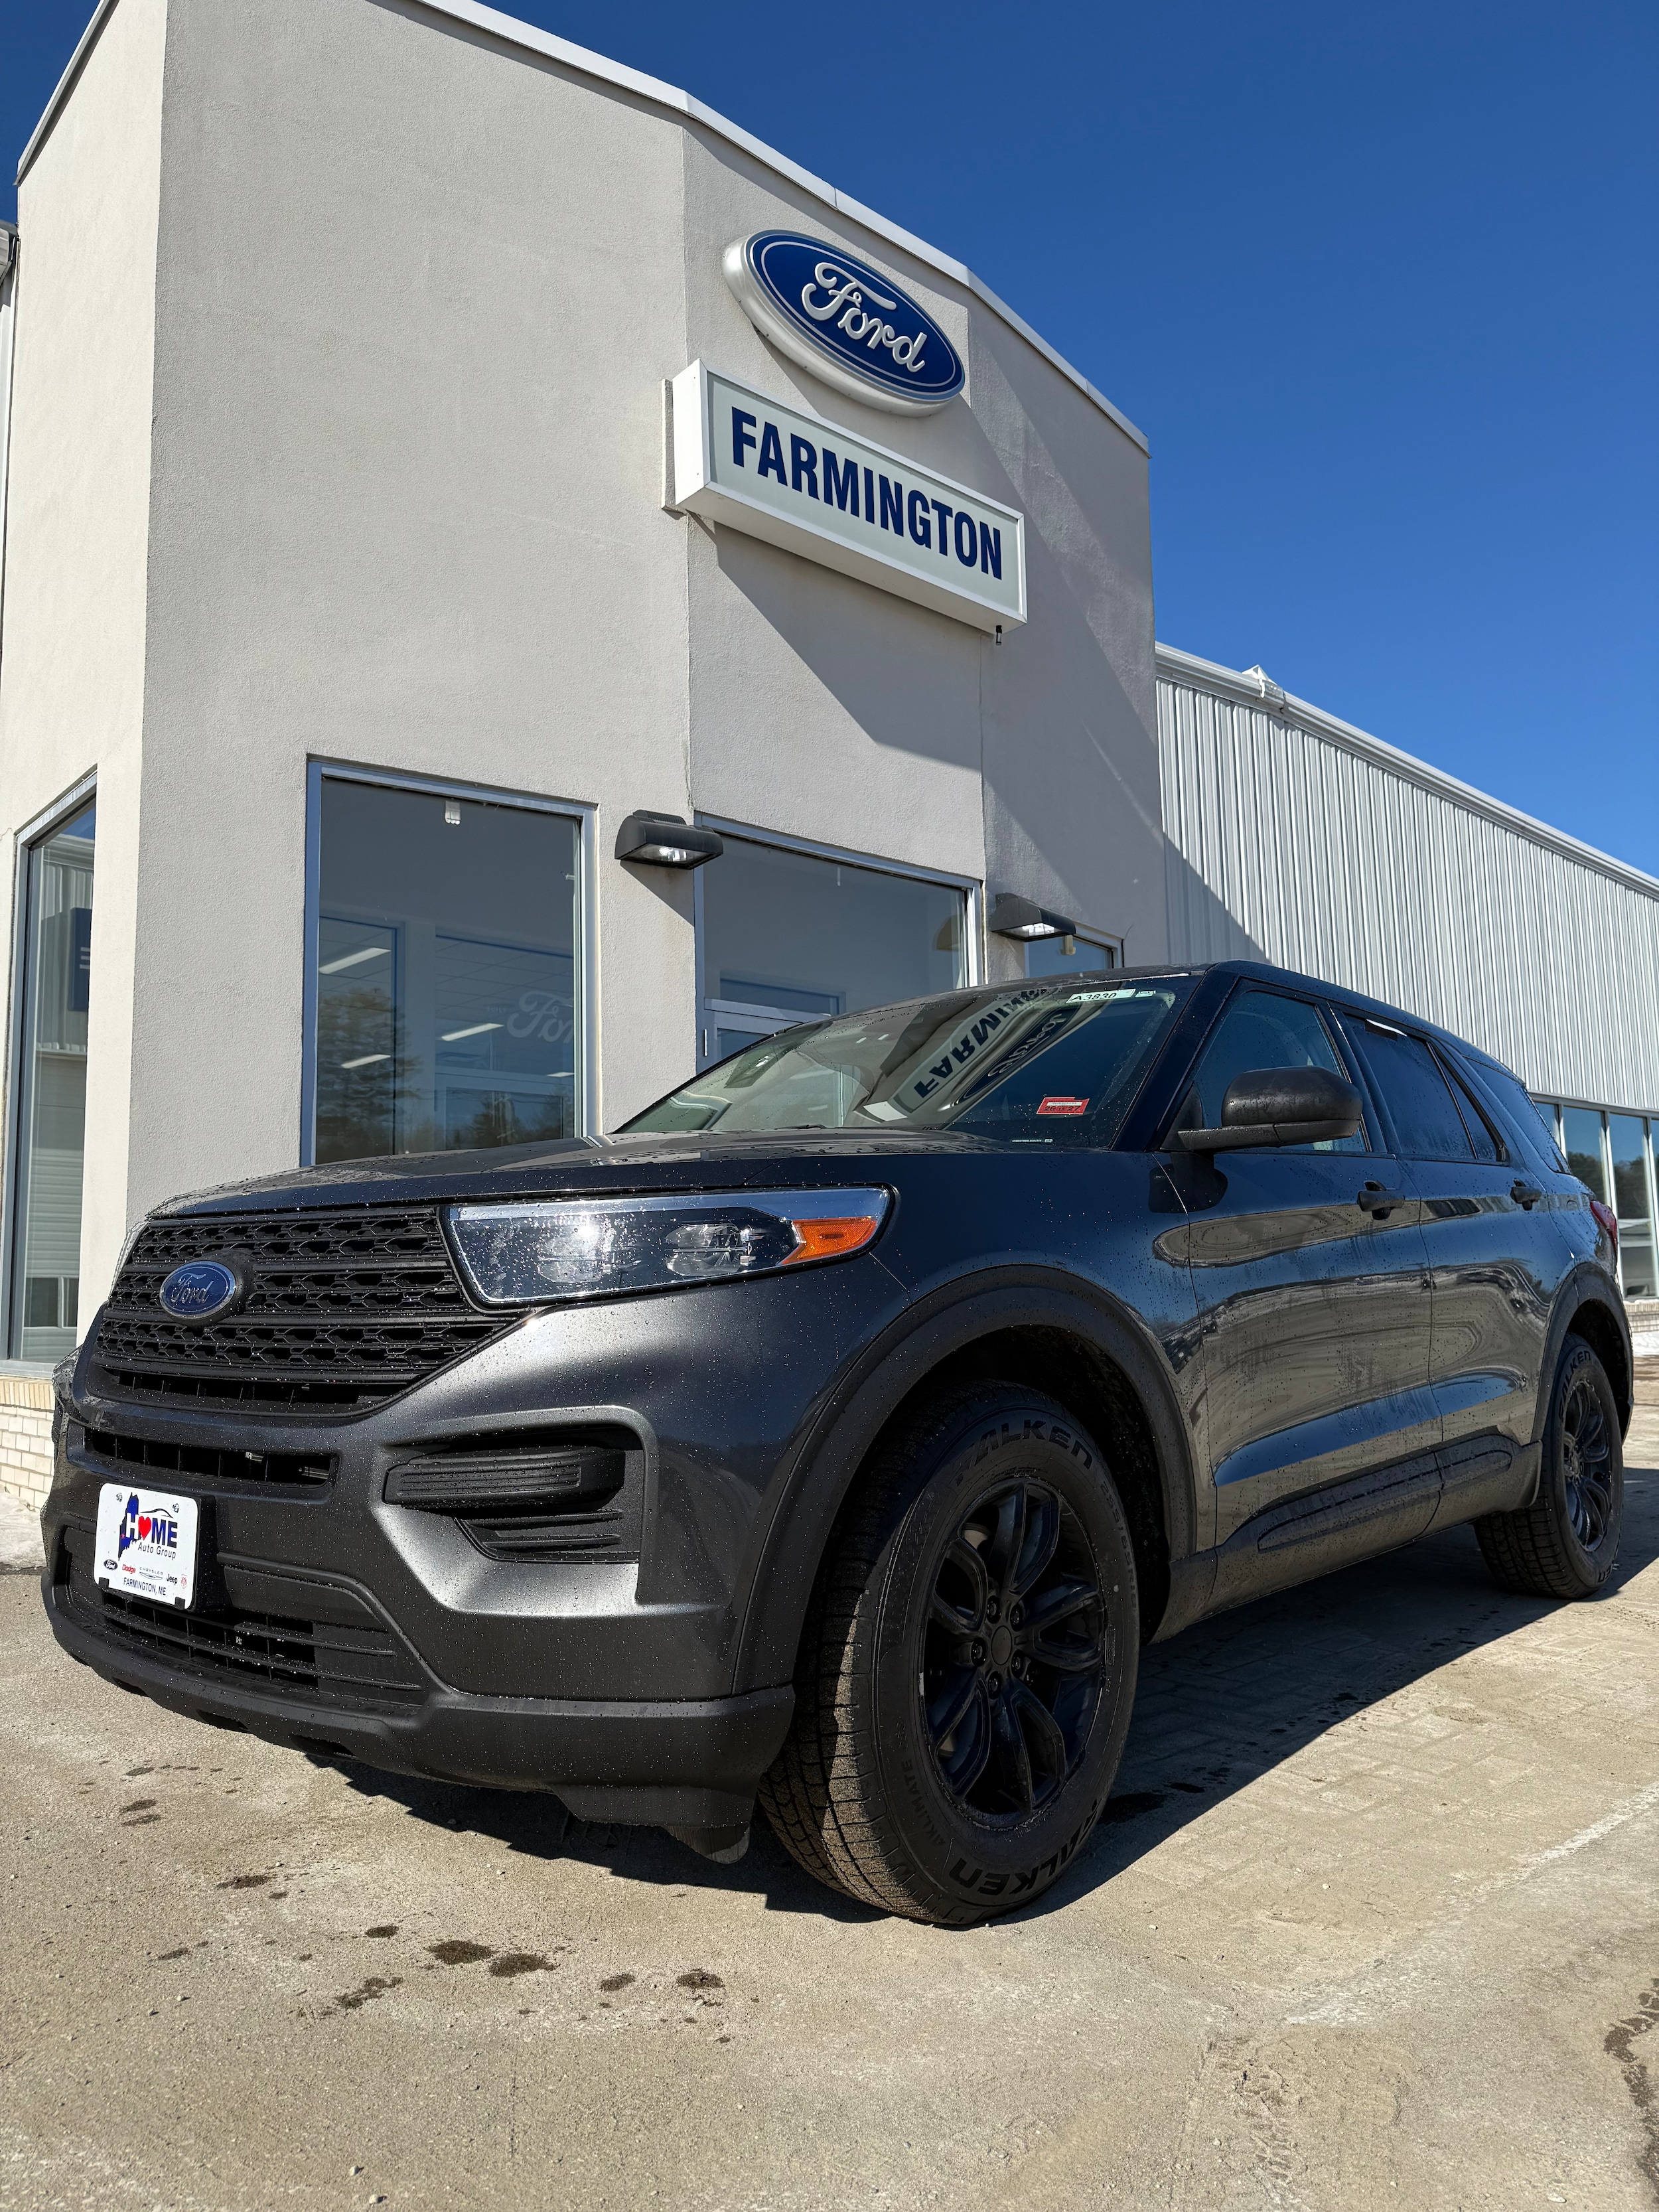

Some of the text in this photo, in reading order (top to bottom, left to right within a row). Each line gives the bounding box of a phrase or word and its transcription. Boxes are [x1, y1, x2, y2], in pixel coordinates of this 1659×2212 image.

[801, 261, 927, 373] Ford
[731, 406, 1003, 581] FARMINGTON
[170, 1272, 214, 1305] Ford
[138, 1542, 177, 1561] Auto Group
[122, 1564, 136, 1575] Dodge
[139, 1566, 163, 1576] CHRYSLER
[167, 1574, 178, 1585] Jeep
[123, 1577, 166, 1595] FARMINGTON, ME
